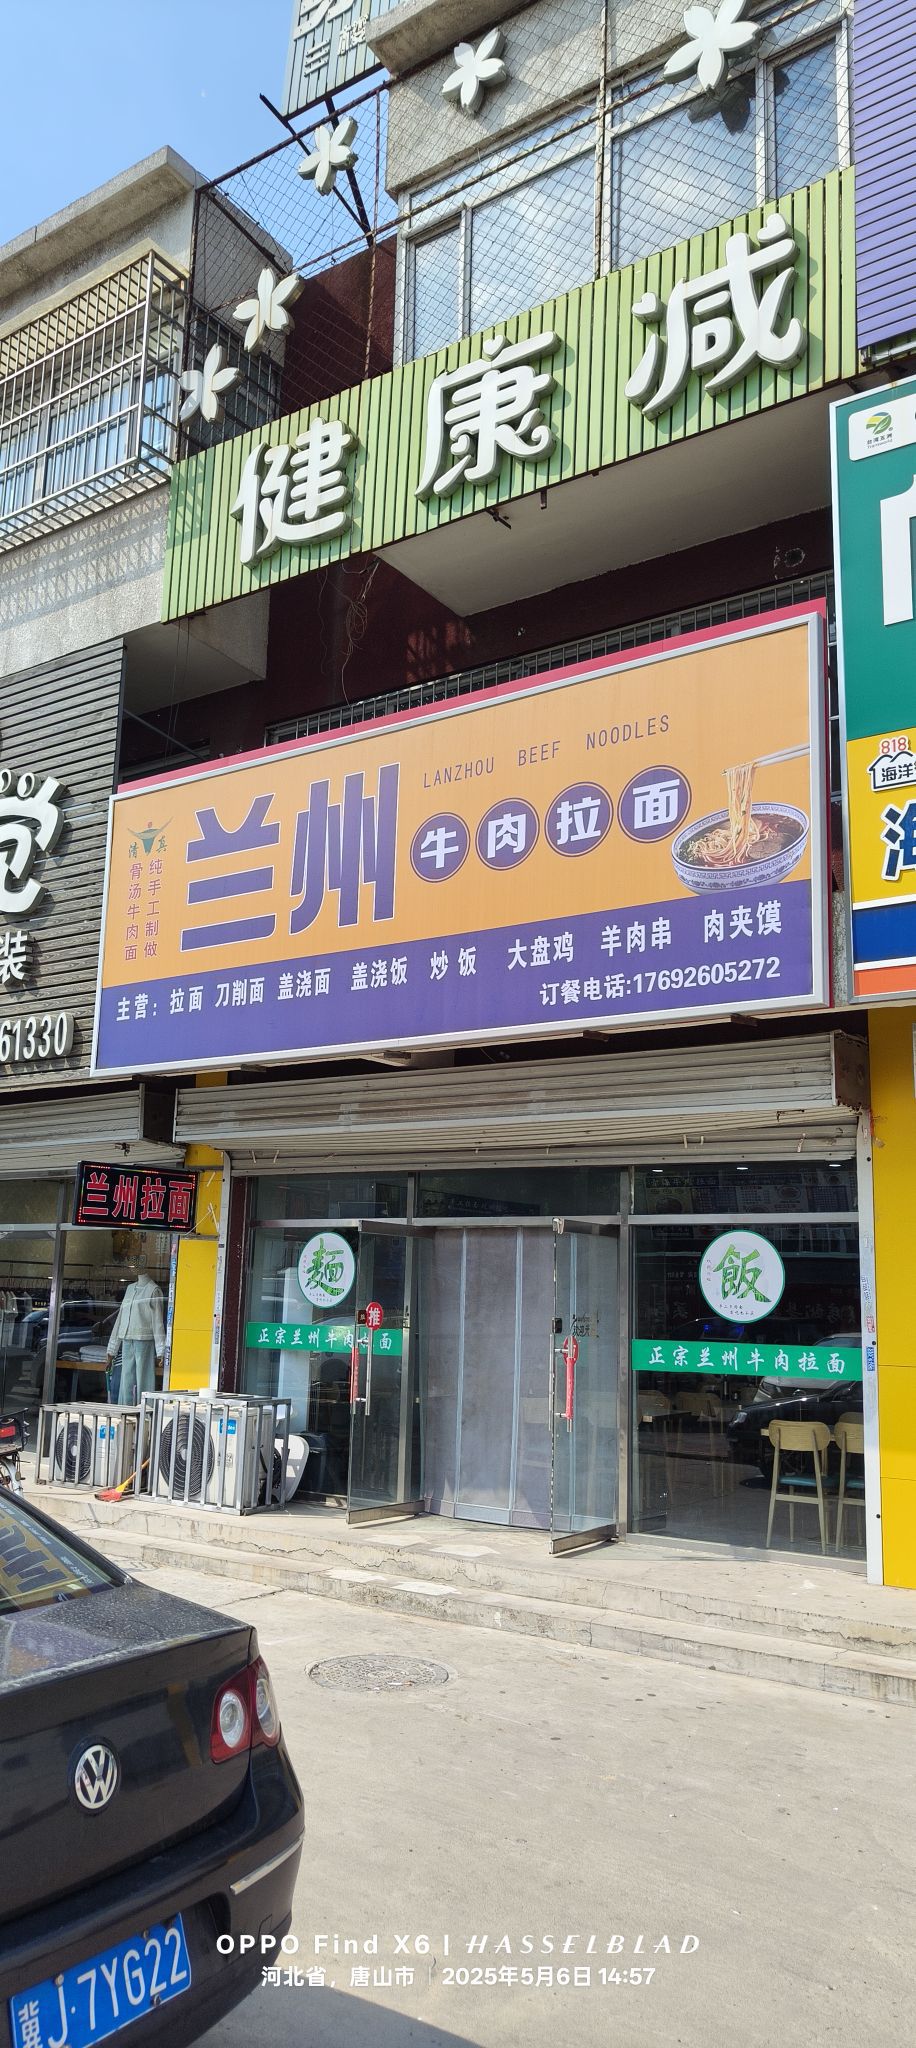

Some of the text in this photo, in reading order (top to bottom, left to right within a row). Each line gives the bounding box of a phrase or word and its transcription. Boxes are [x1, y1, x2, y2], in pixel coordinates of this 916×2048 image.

[230, 212, 808, 568] 健康减
[423, 714, 670, 788] LANZHOU BEEF NOODLES
[881, 737, 907, 754] 818
[881, 761, 916, 782] 海洋
[419, 778, 681, 868] 牛肉拉面
[180, 762, 400, 952] 兰州
[125, 862, 143, 961] 骨汤牛肉面
[144, 858, 163, 958] 纯手工制做
[0, 931, 28, 984] 装
[170, 985, 204, 1015] 拉面
[215, 976, 265, 1008] 刀削面
[277, 967, 331, 1001] 盖浇面
[351, 956, 407, 992] 盖浇饭
[507, 931, 574, 970] 大盘鸡
[600, 916, 672, 957] 羊肉串
[704, 900, 782, 943] 肉夹馍
[540, 956, 781, 1006] 订餐电话:17692605272
[0, 1012, 68, 1061] 61330
[82, 1172, 193, 1223] 兰州拉面
[368, 1306, 381, 1327] 推
[648, 1345, 845, 1374] 正宗兰州牛肉拉面
